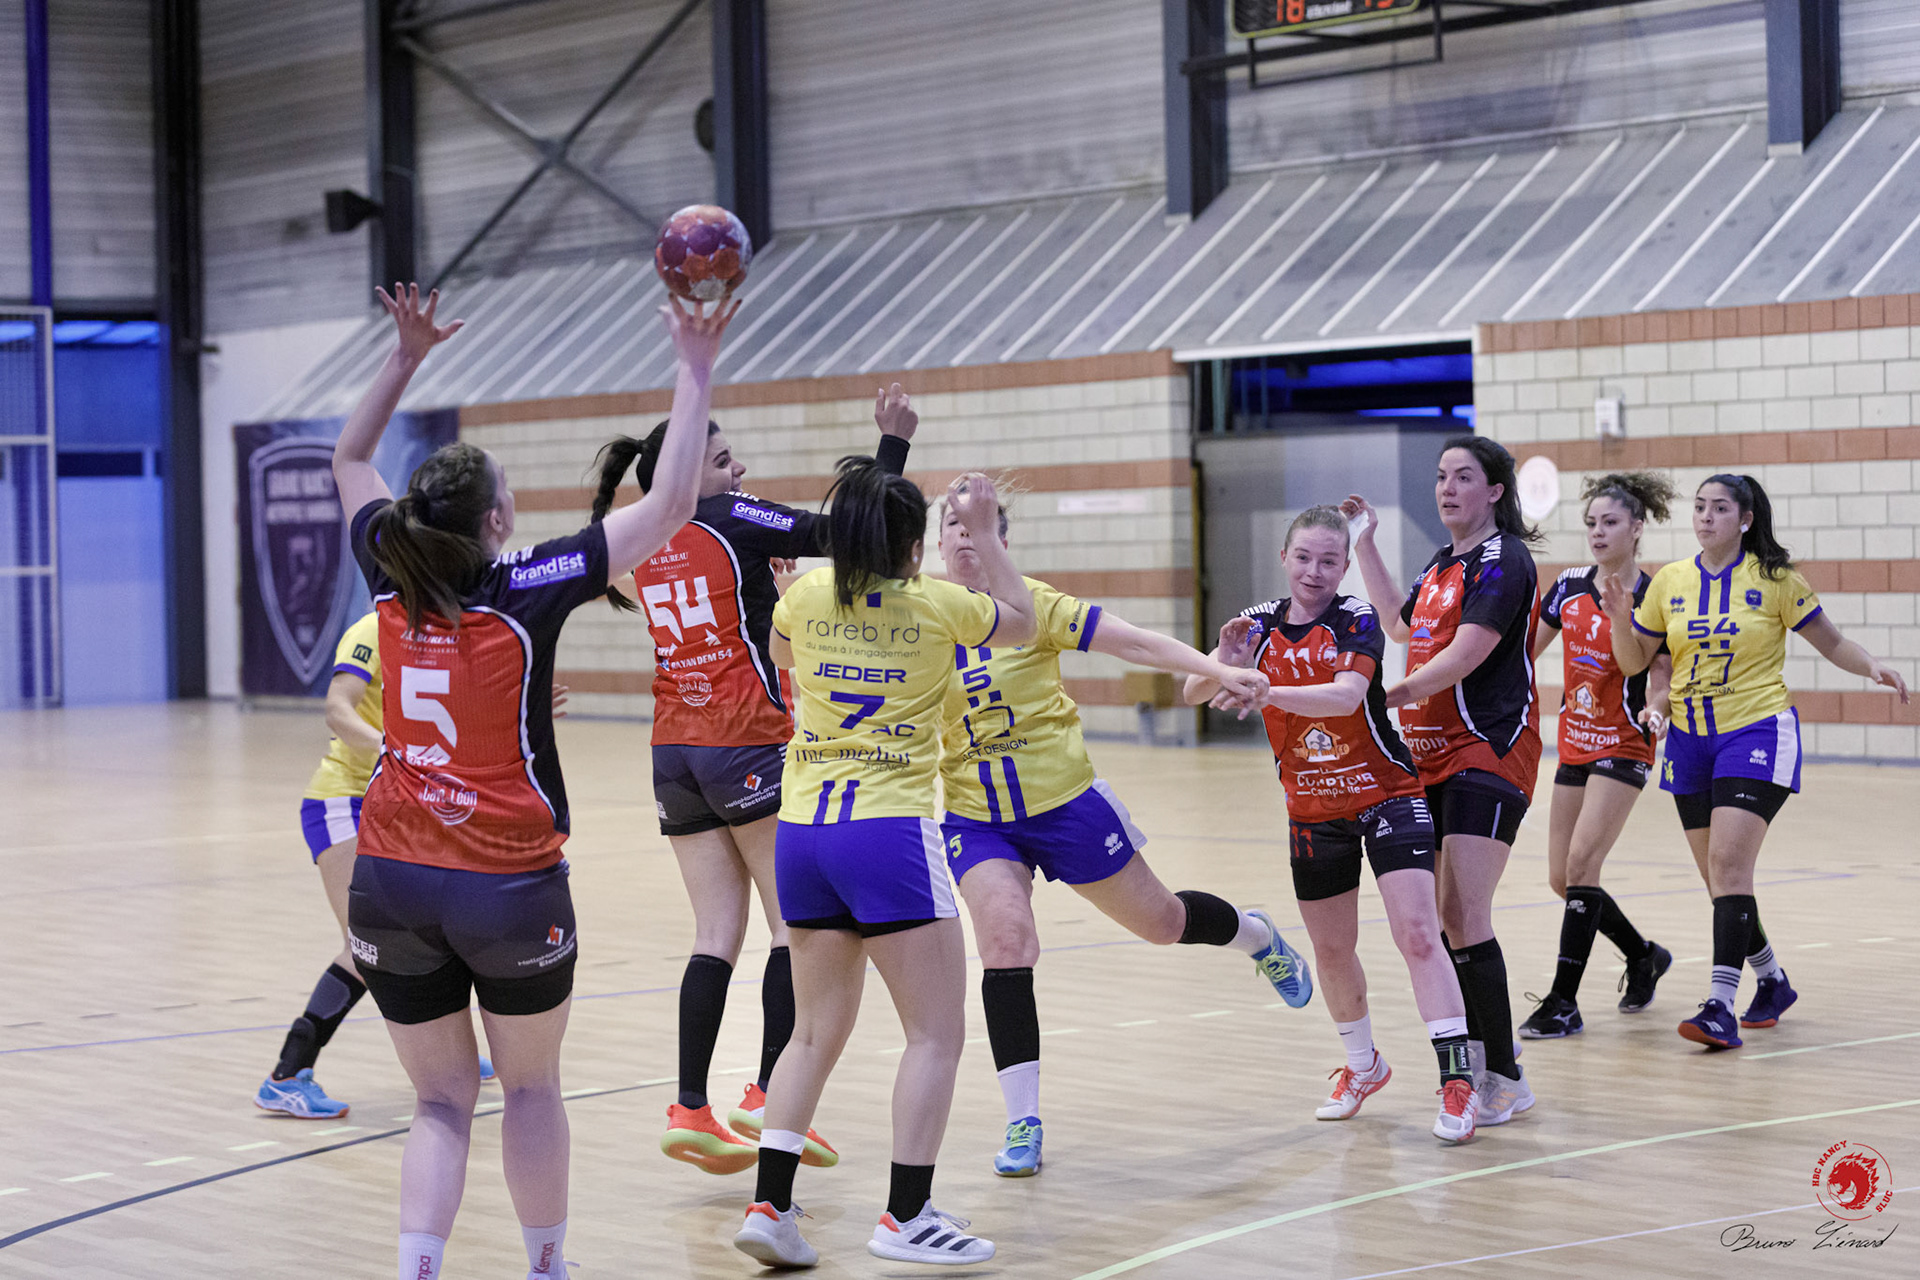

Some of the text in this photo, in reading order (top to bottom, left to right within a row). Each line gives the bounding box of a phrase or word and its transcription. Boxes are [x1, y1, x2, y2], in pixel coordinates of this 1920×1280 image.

[641, 575, 718, 644] 54
[806, 619, 920, 644] rarebrd
[1687, 617, 1740, 640] 54
[718, 648, 733, 660] 54
[805, 641, 816, 650] du
[818, 644, 837, 653] sens
[840, 646, 846, 654] à
[1569, 641, 1582, 655] Guy
[813, 662, 907, 684] JEDER
[1283, 648, 1315, 679] 11
[962, 665, 992, 694] 5
[400, 666, 457, 749] 5
[830, 690, 885, 730] 7
[1405, 724, 1413, 733] LE
[1580, 720, 1591, 729] LE
[984, 738, 1028, 756] DESIGN
[1291, 826, 1313, 858] 11
[533, 1241, 556, 1274] Kempa
